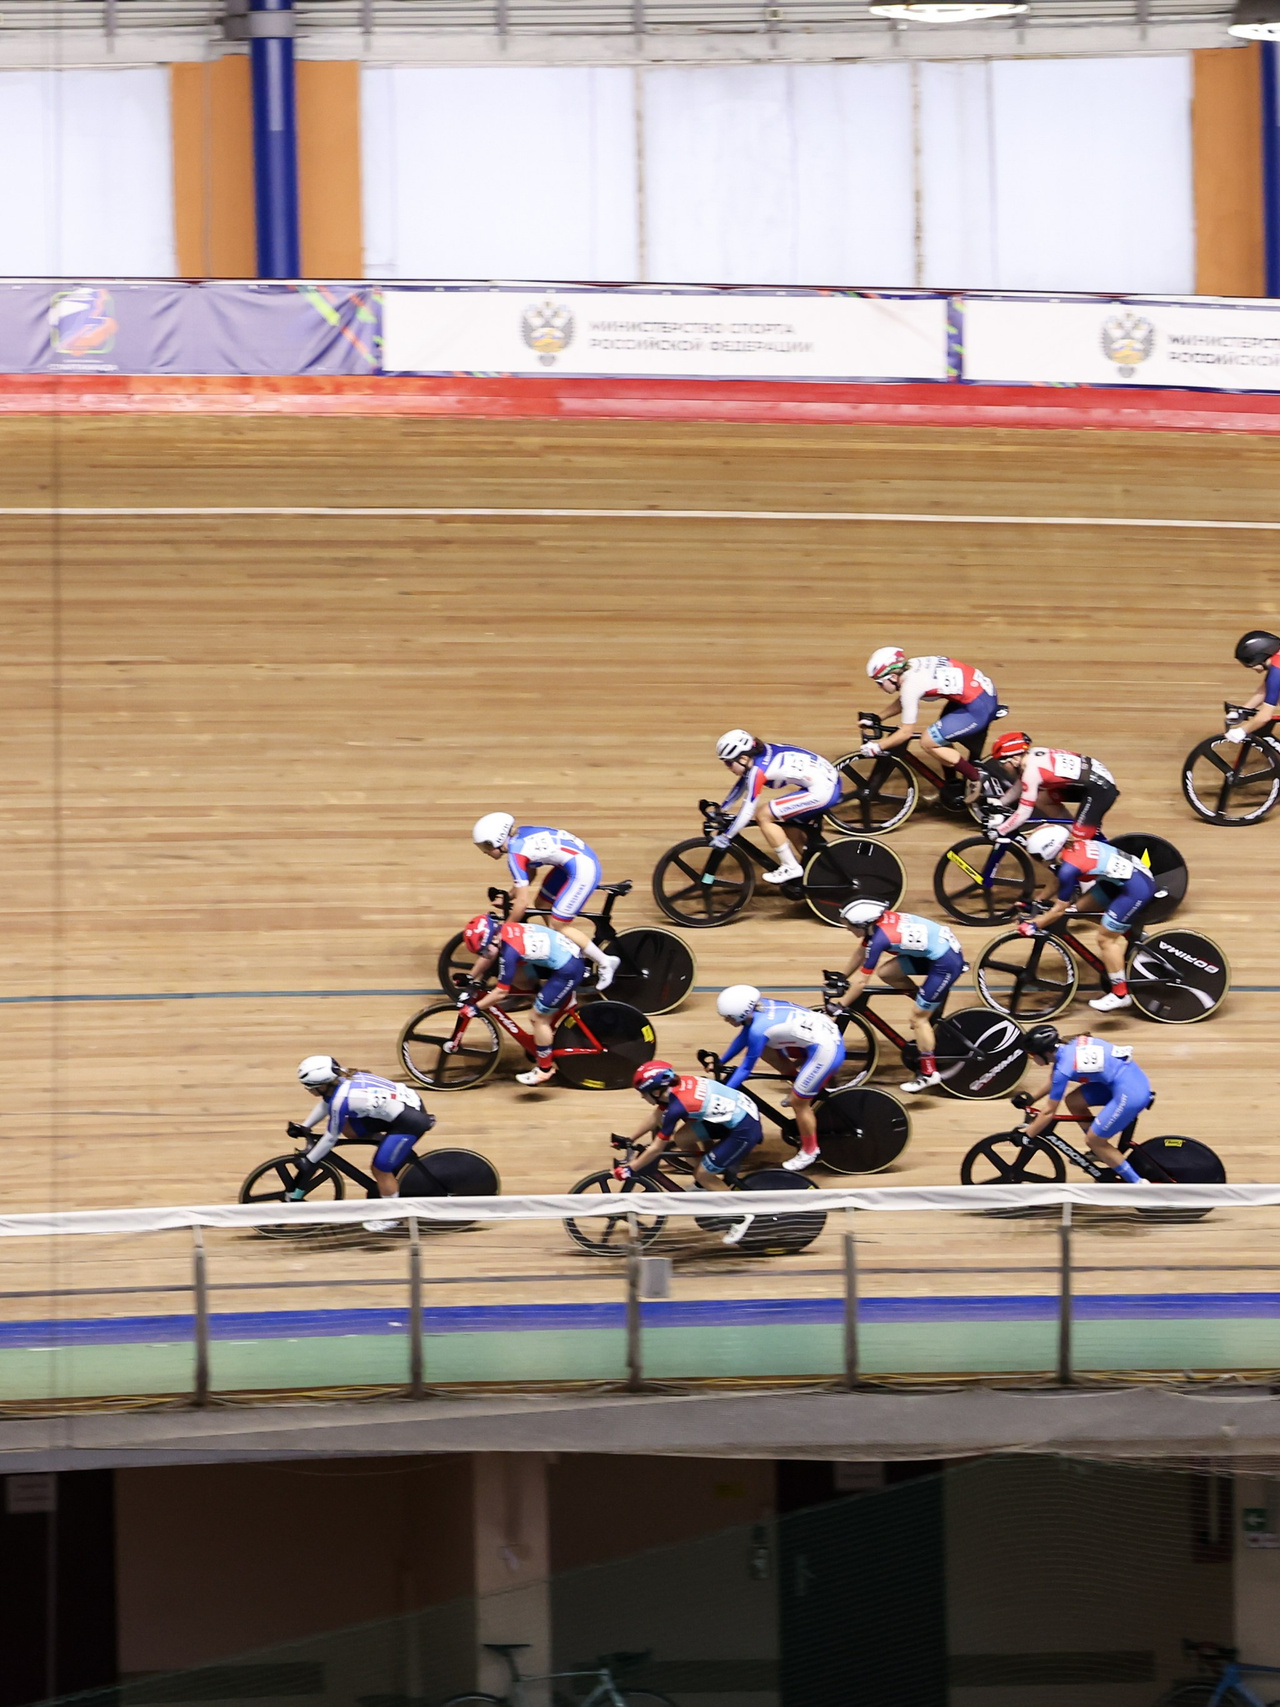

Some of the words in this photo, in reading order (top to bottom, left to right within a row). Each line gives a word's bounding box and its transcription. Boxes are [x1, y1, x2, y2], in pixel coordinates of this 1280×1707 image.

[588, 321, 723, 333] МИНИСТЕРСТВО
[730, 323, 796, 334] СПОРТА
[588, 337, 704, 351] РОССИЙСКОЙ
[708, 340, 814, 352] ФЕДЕРАЦИИ
[1046, 1134, 1091, 1168] ARGON
